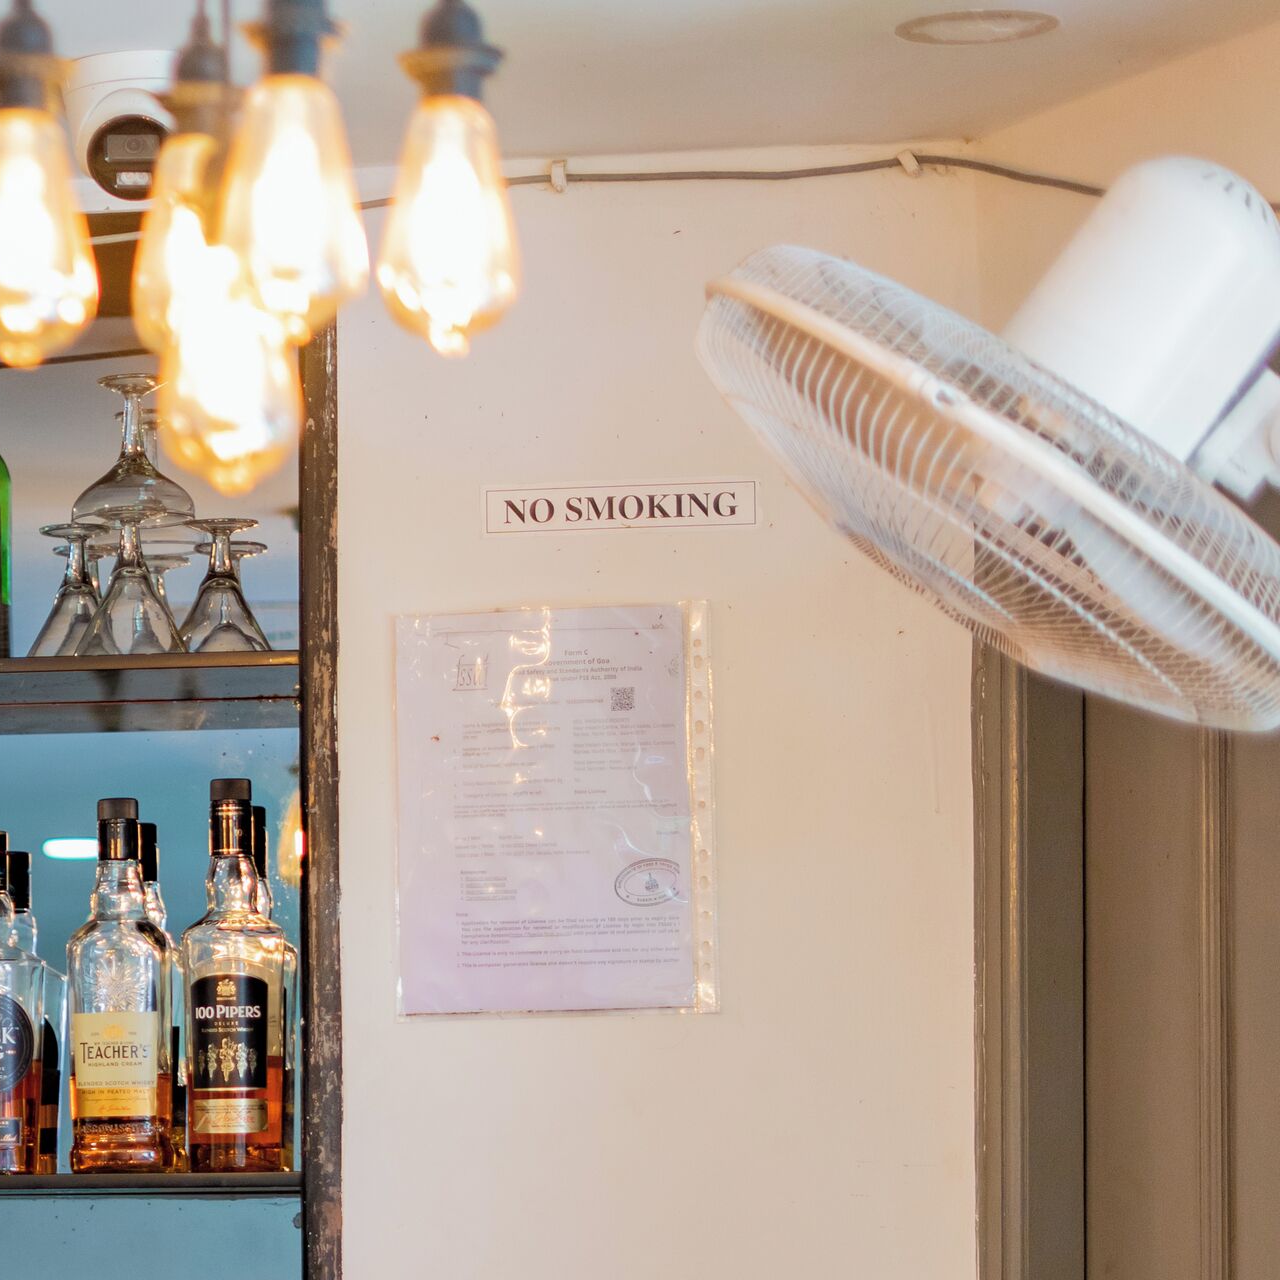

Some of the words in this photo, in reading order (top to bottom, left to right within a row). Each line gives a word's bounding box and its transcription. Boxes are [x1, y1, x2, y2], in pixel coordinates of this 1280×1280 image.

[503, 498, 555, 524] NO
[565, 491, 738, 522] SMOKING
[195, 1007, 214, 1019] 100
[216, 1004, 261, 1019] PIPERS
[79, 1042, 150, 1064] TEACHER'S
